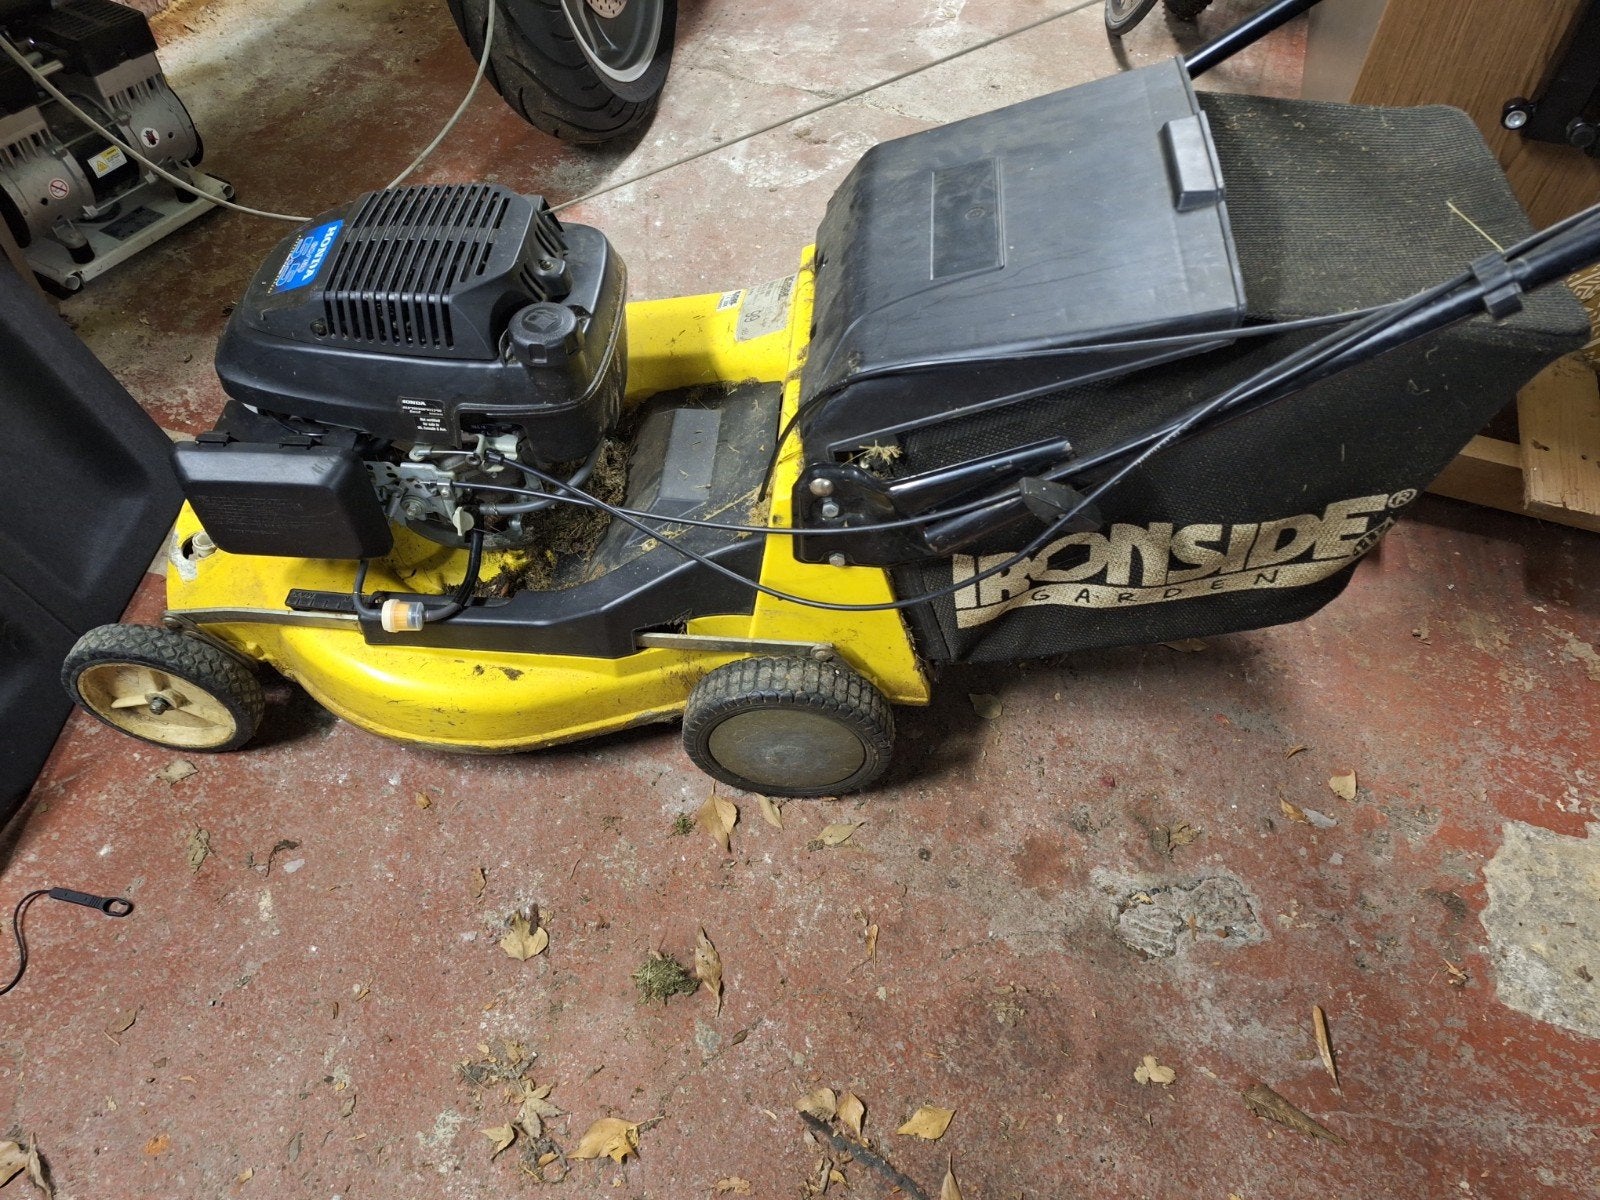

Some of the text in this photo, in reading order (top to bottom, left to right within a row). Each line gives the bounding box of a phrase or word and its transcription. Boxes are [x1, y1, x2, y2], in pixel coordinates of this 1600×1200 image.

[302, 225, 338, 281] HONDA
[952, 493, 1389, 611] IRONSIDE
[1031, 569, 1279, 604] GARDEN
